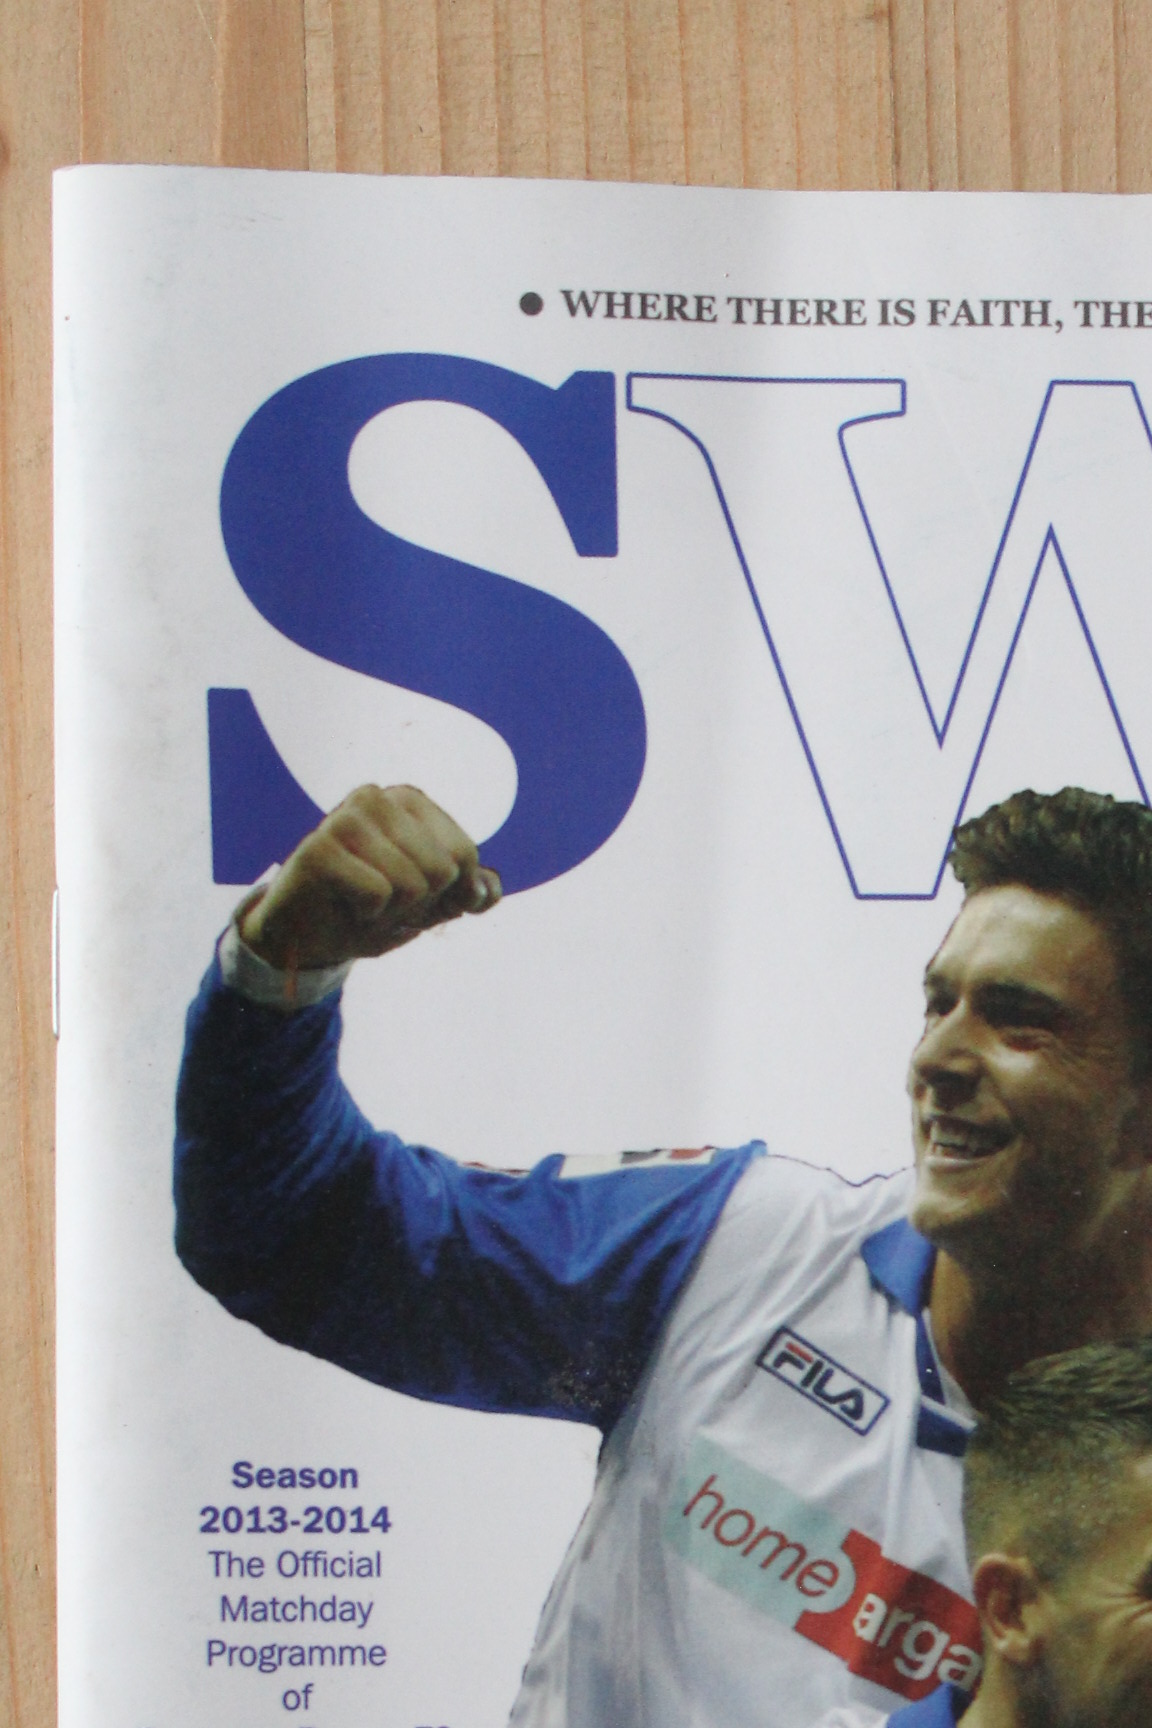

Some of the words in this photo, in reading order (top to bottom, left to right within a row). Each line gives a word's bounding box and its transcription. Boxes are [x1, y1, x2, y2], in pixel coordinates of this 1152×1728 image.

[560, 289, 719, 323] WHERE
[725, 296, 869, 327] THERE
[877, 298, 916, 327] IS
[927, 299, 1065, 334] FAITH,
[772, 1340, 866, 1421] FILA
[231, 1460, 360, 1490] Season
[199, 1505, 392, 1534] 2013-2014
[683, 1473, 840, 1597] home
[207, 1551, 265, 1578] The
[277, 1549, 383, 1578] Official
[220, 1595, 374, 1629] Matchday
[206, 1640, 388, 1674] Programme
[281, 1683, 315, 1712] of
